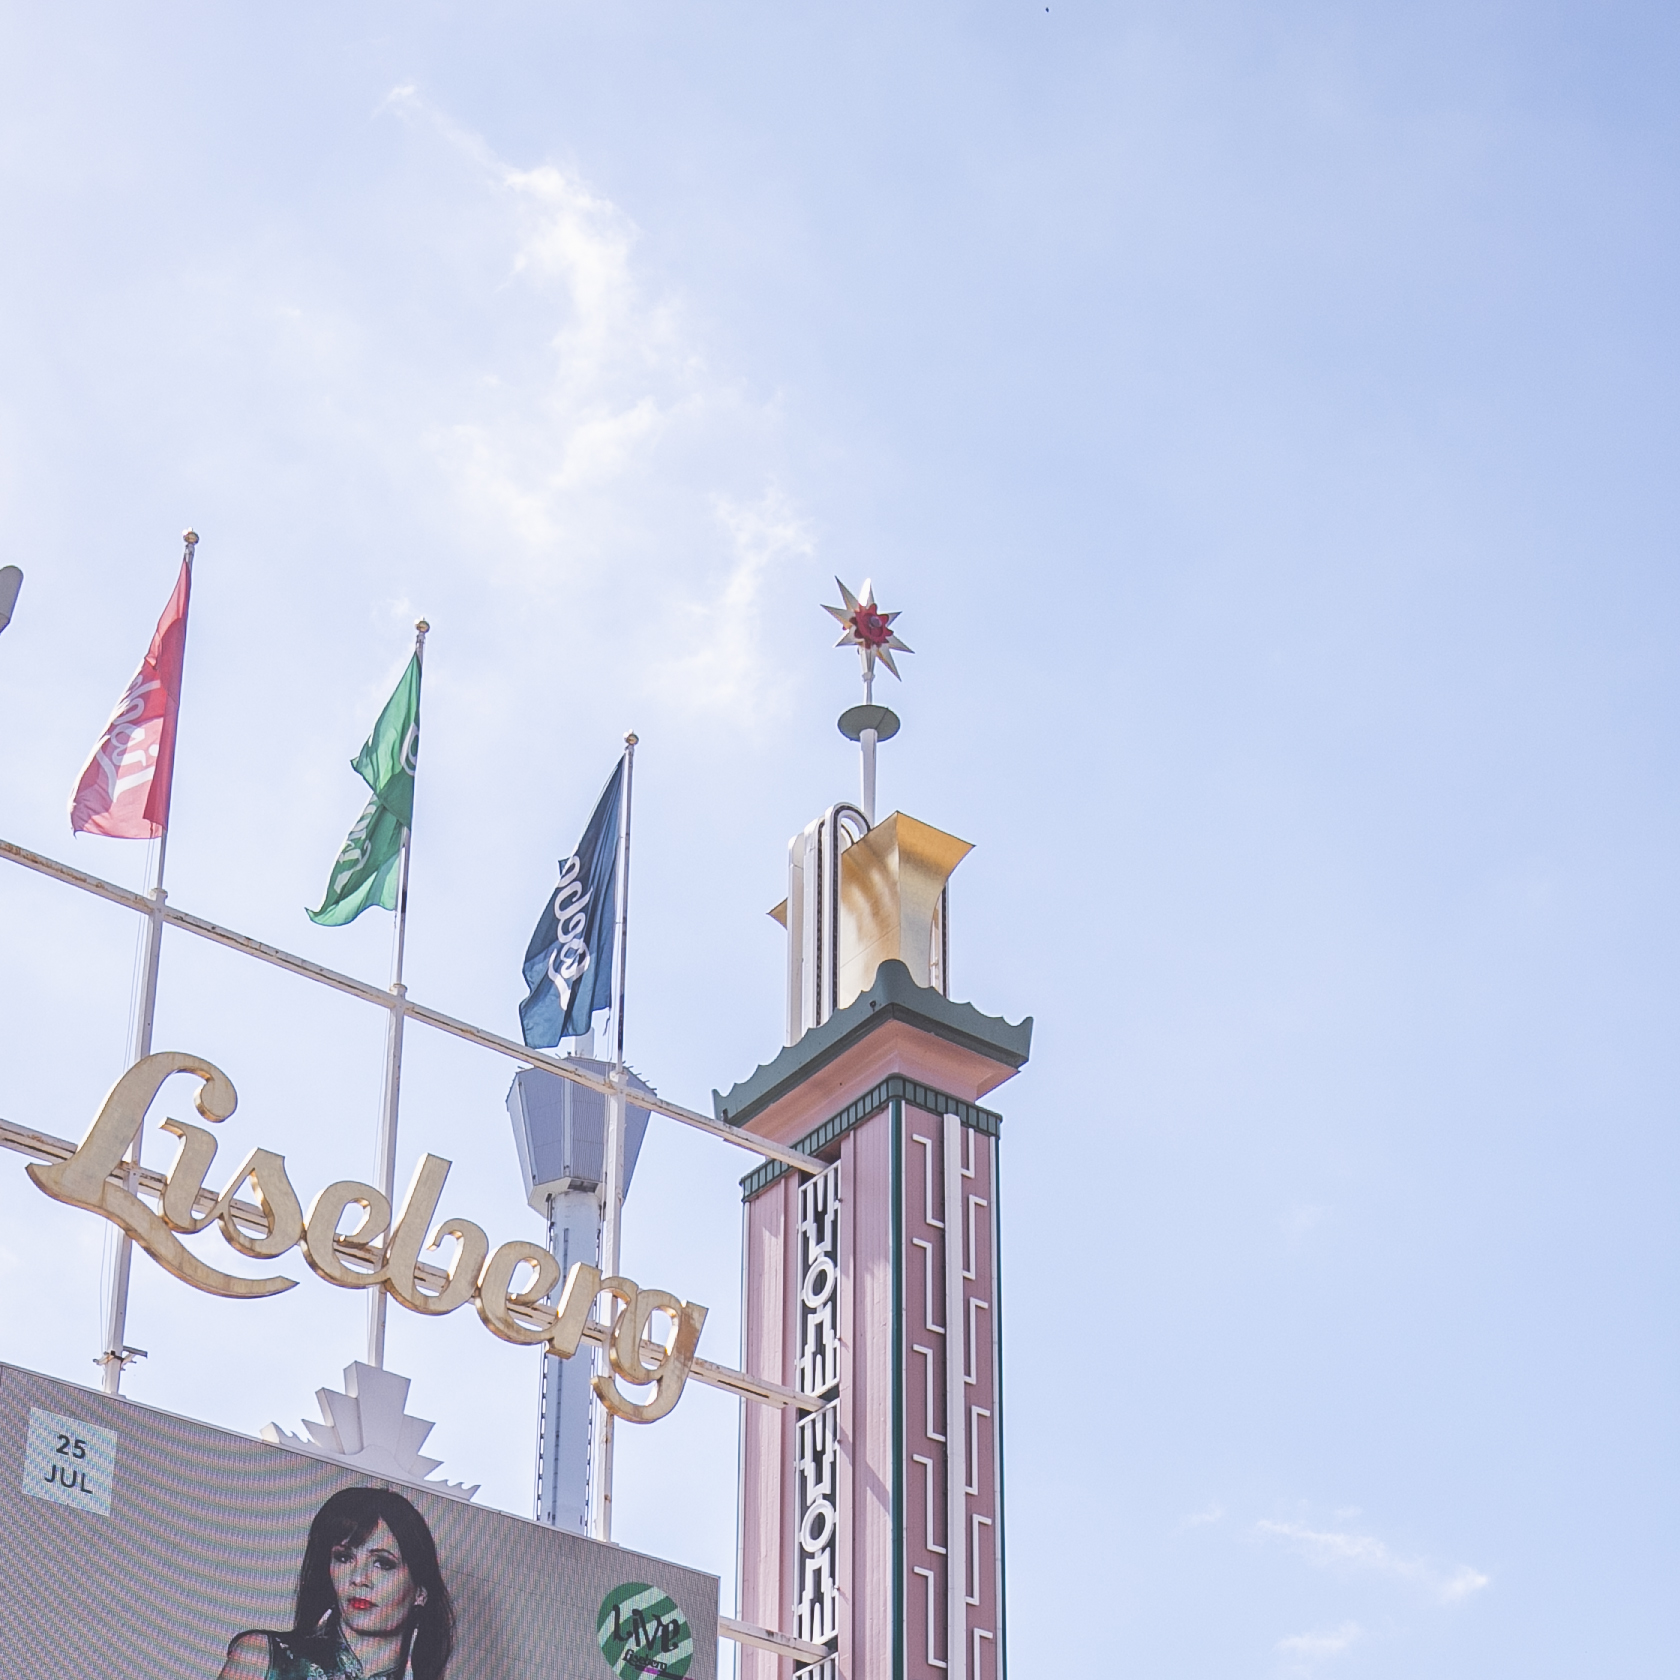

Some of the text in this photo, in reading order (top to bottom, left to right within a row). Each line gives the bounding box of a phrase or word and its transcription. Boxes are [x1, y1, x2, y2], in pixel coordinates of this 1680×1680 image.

[26, 1051, 709, 1424] Liseberg
[56, 1434, 86, 1459] 25
[44, 1464, 93, 1494] JUL
